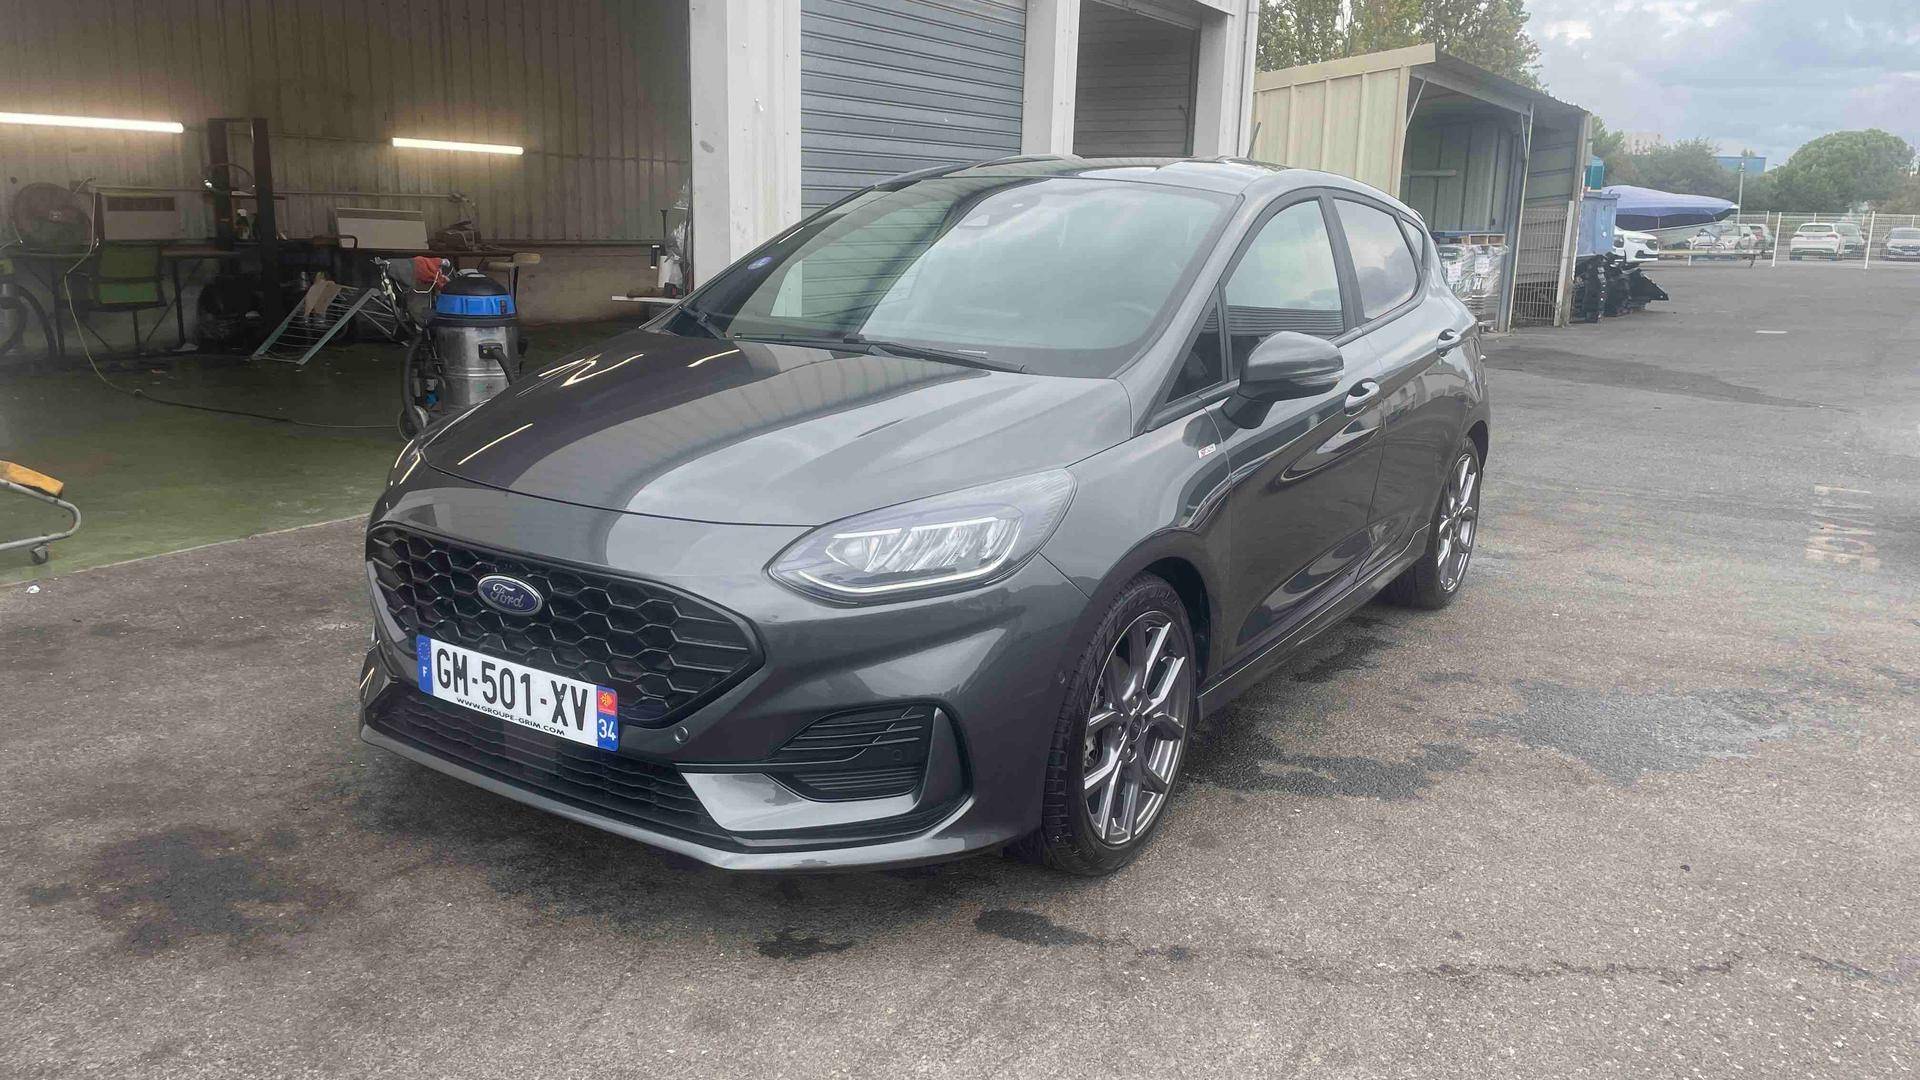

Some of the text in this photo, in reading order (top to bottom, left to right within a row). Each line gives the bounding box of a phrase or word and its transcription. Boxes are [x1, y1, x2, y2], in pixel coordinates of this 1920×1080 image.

[490, 583, 524, 607] Ford
[422, 665, 429, 677] F
[436, 648, 588, 731] GM-501-XV
[456, 697, 565, 736] WWW.GROUPE-GRIM.COM
[598, 718, 616, 741] 34
